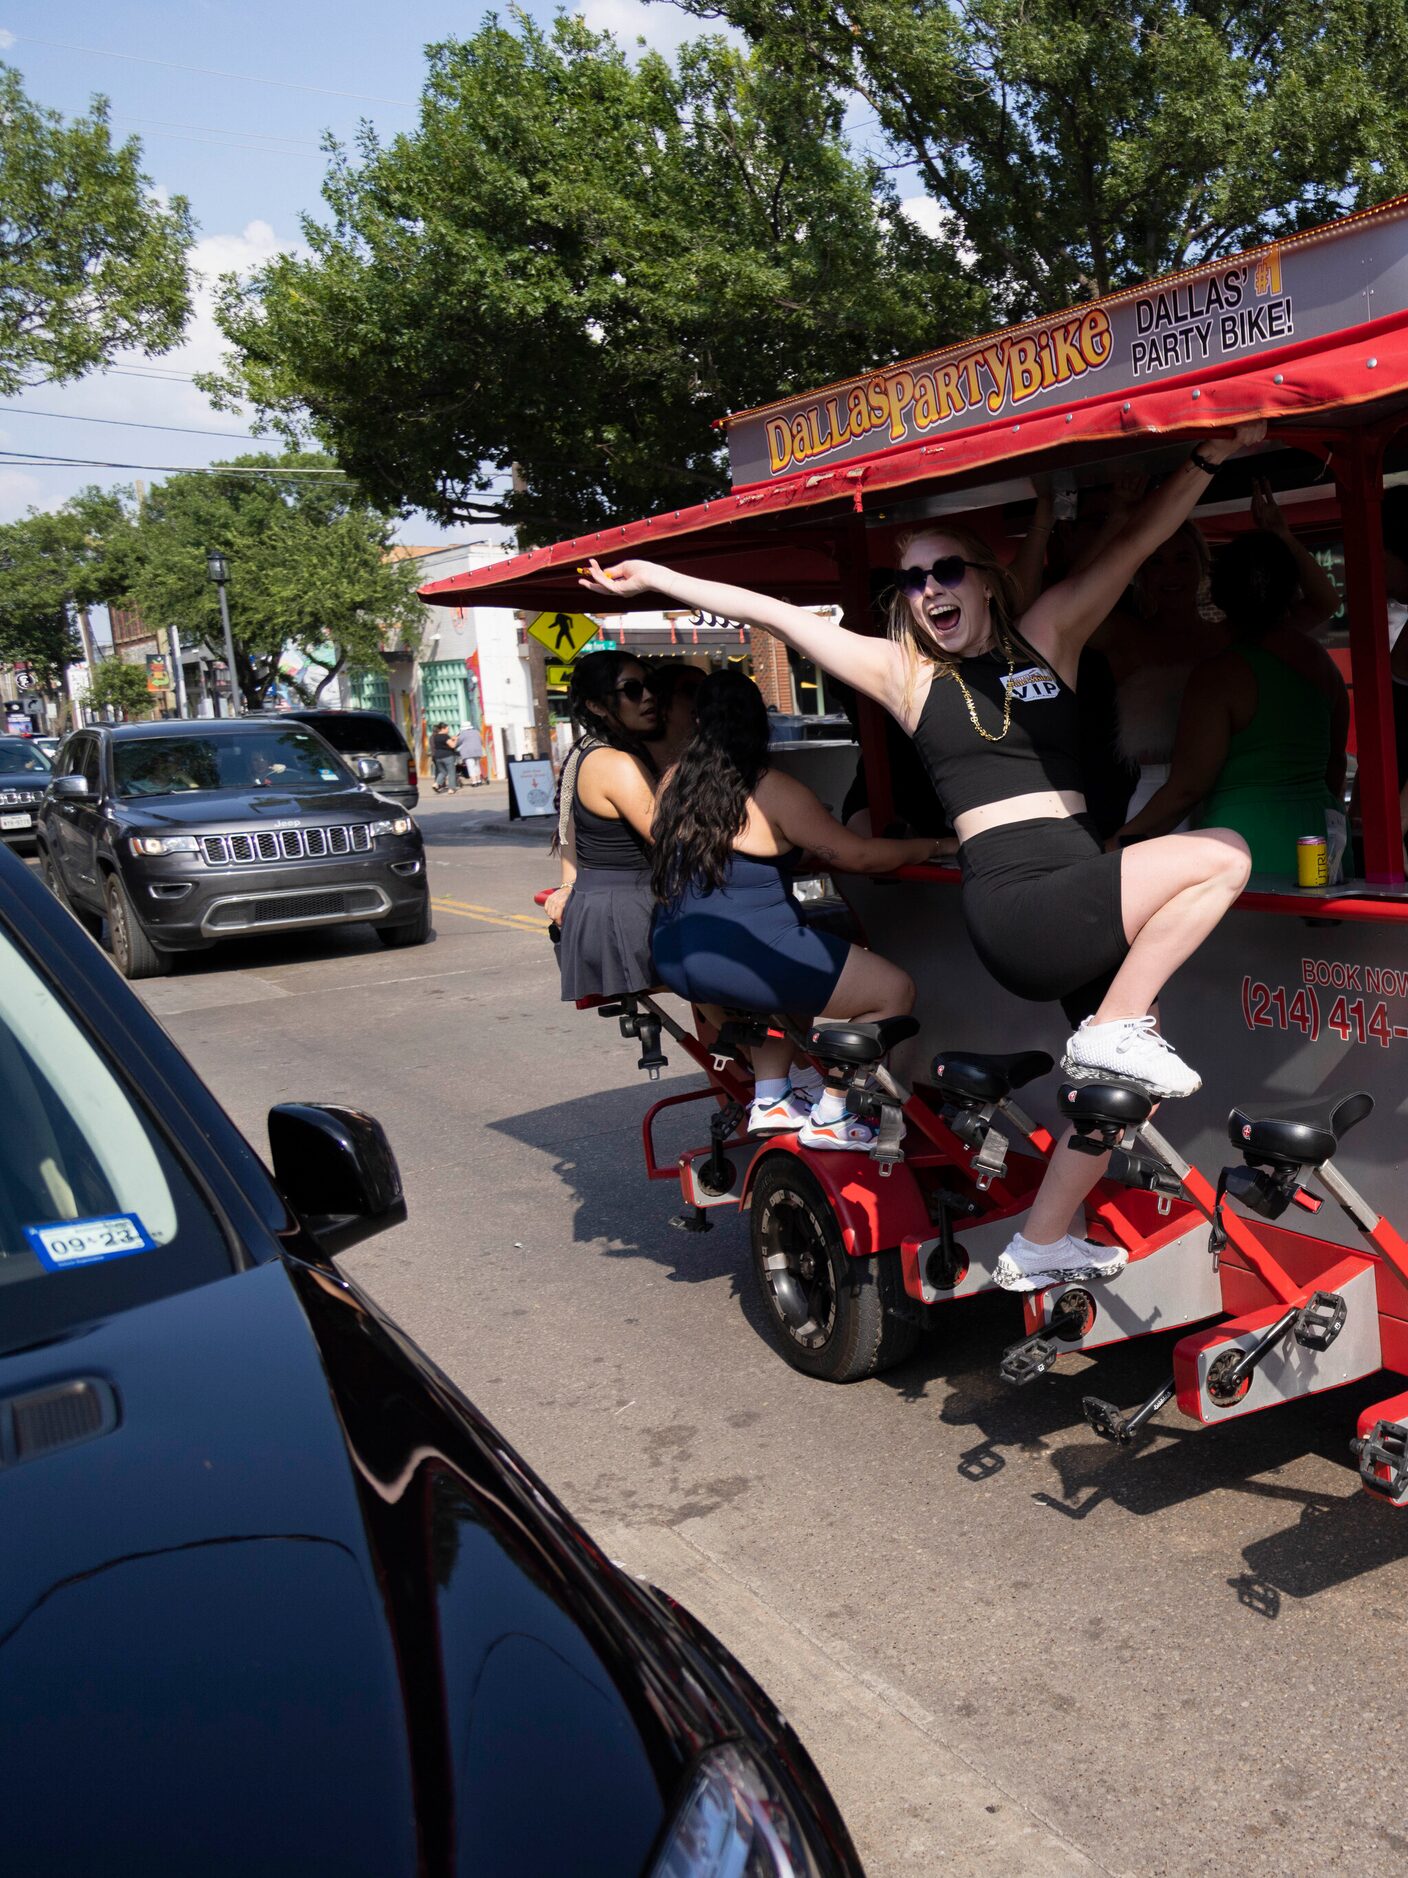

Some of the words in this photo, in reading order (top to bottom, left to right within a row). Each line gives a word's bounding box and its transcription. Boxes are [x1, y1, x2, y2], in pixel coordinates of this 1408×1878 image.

[1135, 265, 1248, 337] DALLAS'
[1255, 245, 1283, 297] #1
[1131, 319, 1214, 377] PARTY
[1219, 296, 1294, 353] BIKE!
[1012, 682, 1057, 699] VIP
[274, 819, 301, 828] Jeep
[1301, 958, 1363, 991] BOOK
[1241, 975, 1320, 1042] (214)
[50, 1236, 86, 1256] 09
[99, 1229, 136, 1247] 23
